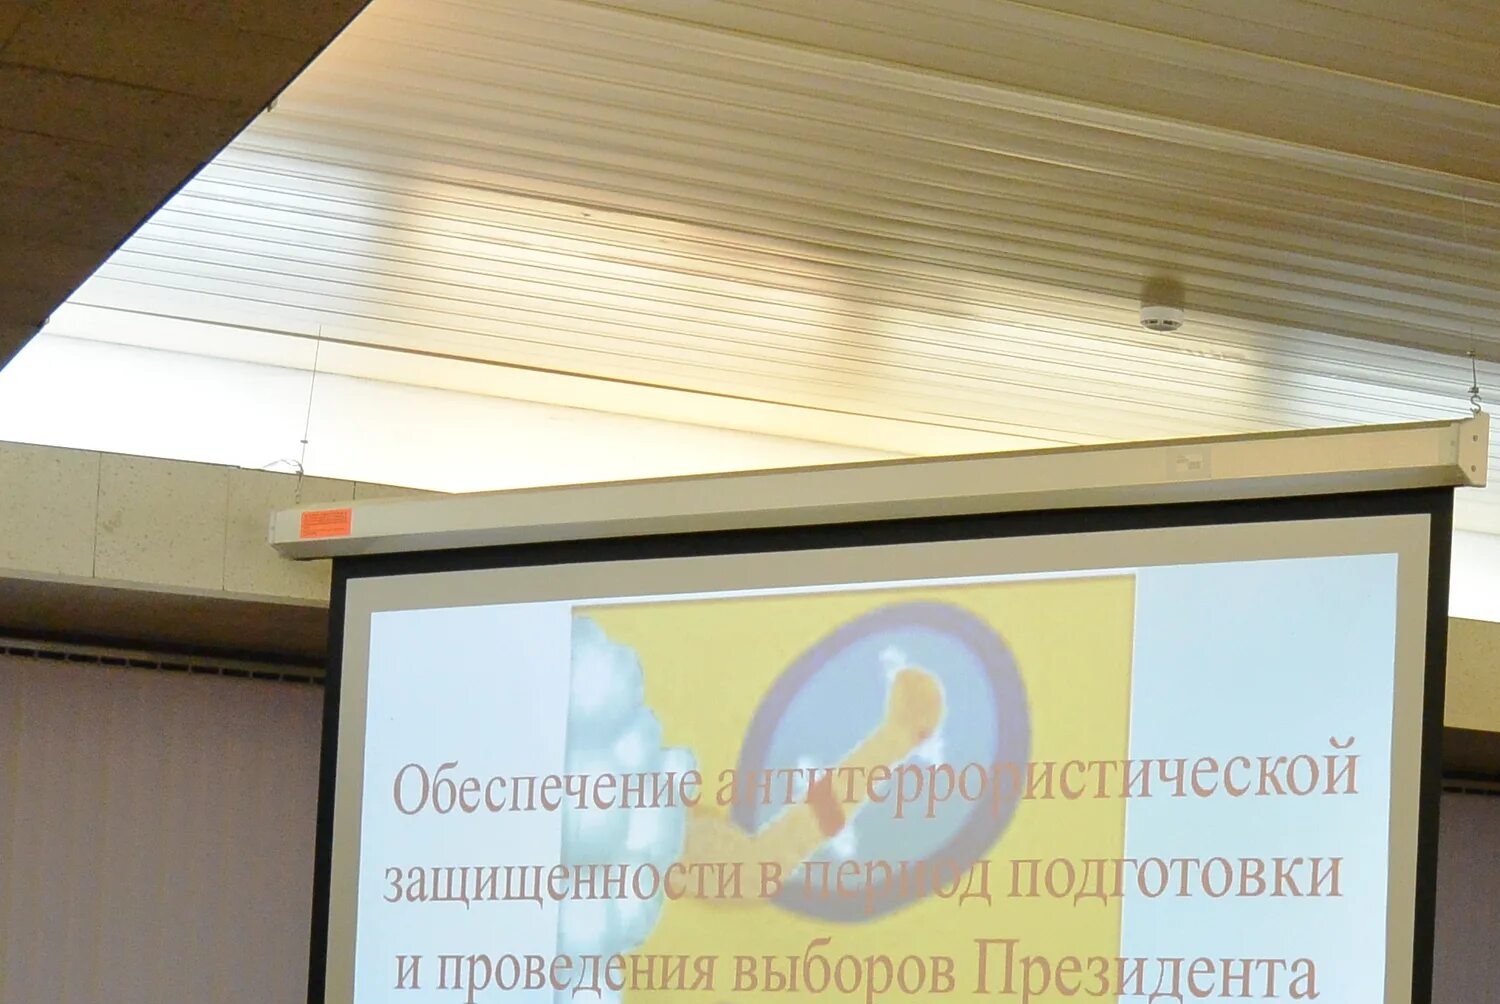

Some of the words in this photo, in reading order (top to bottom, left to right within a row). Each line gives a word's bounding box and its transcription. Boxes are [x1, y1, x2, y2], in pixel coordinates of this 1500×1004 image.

[393, 761, 702, 815] Обеспечение
[716, 735, 1360, 819] антитеррористической
[383, 861, 743, 910] защищенности
[760, 861, 783, 898] в
[802, 857, 993, 914] период
[1008, 856, 1344, 907] подготовки
[394, 955, 422, 990] и
